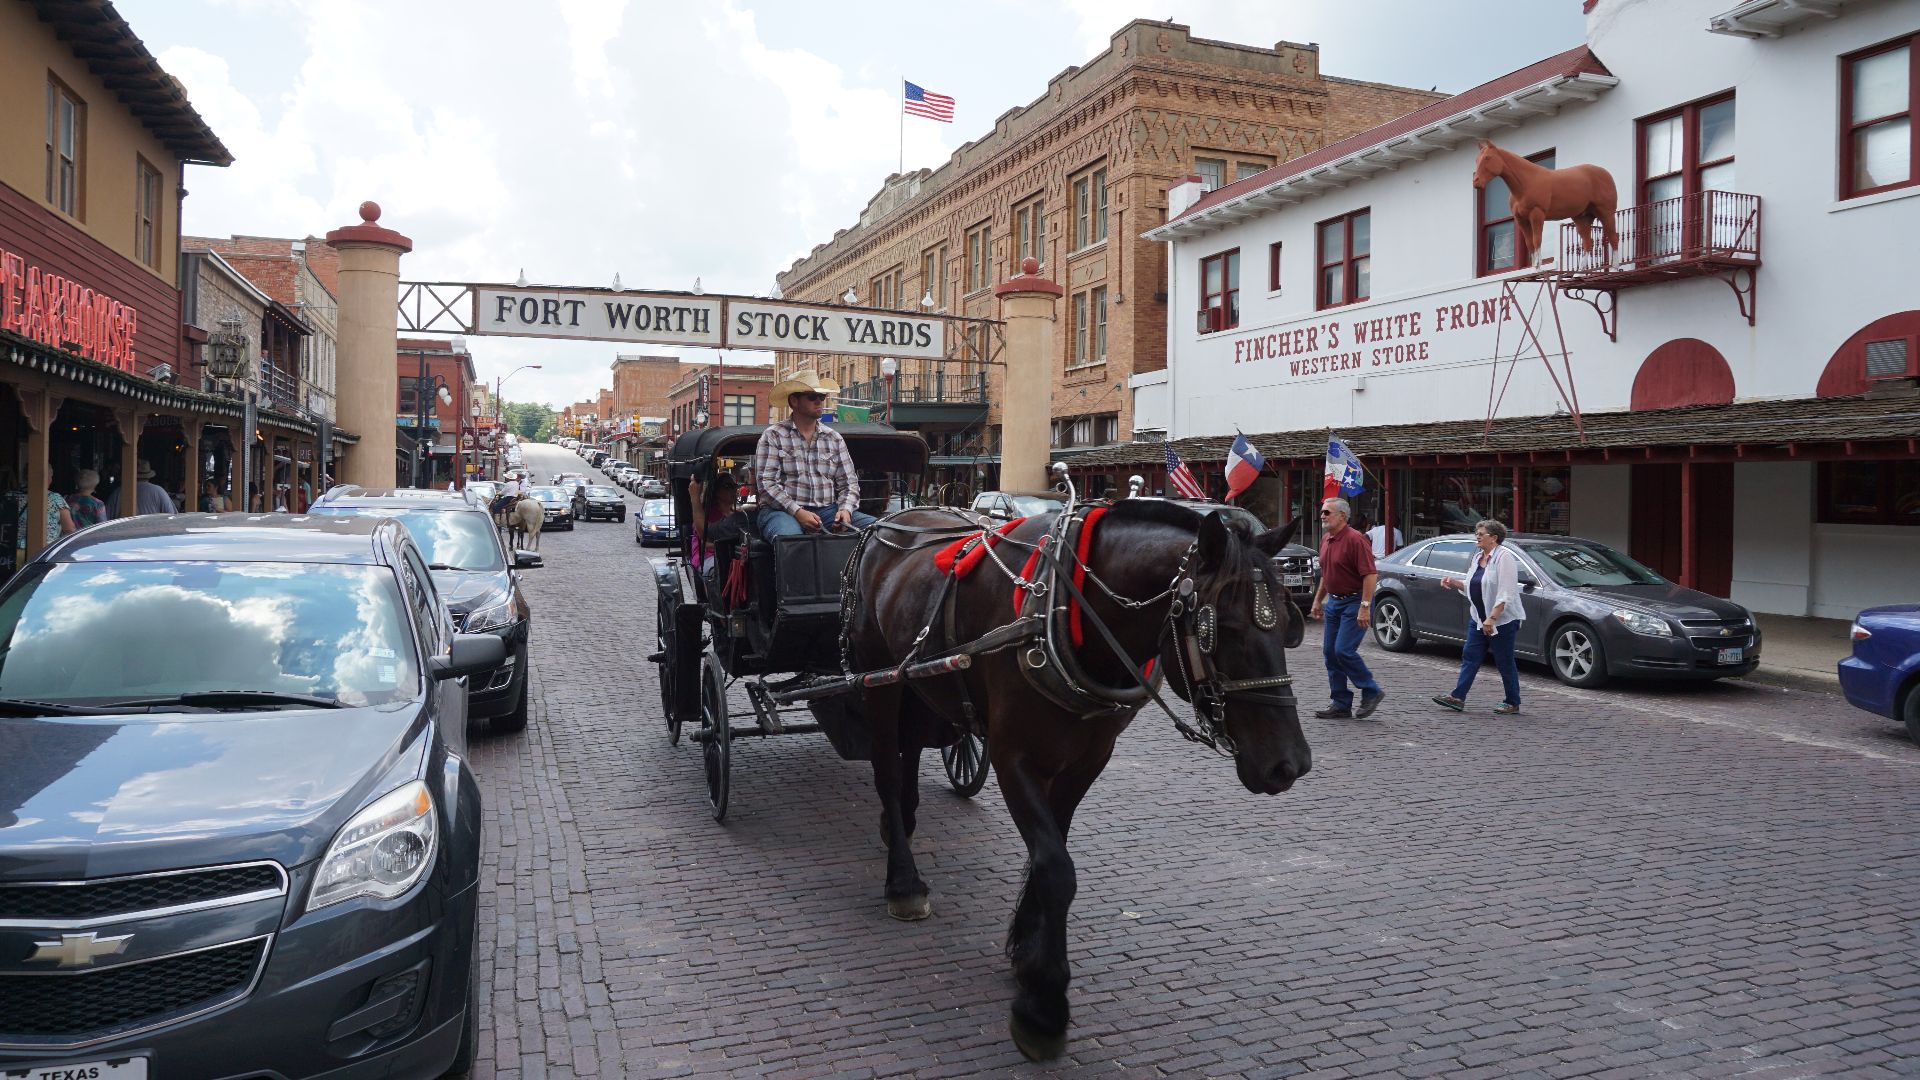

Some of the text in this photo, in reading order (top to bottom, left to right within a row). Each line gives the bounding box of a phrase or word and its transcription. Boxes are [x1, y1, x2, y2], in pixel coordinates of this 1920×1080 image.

[0, 247, 137, 376] EAKHOUSE
[495, 295, 932, 348] FORT WORTH STOCK YARDS
[1234, 295, 1515, 364] FINCHER'S WHITE FRONT
[1290, 341, 1429, 377] WESTERN STORE
[40, 1067, 99, 1080] TEXAS
